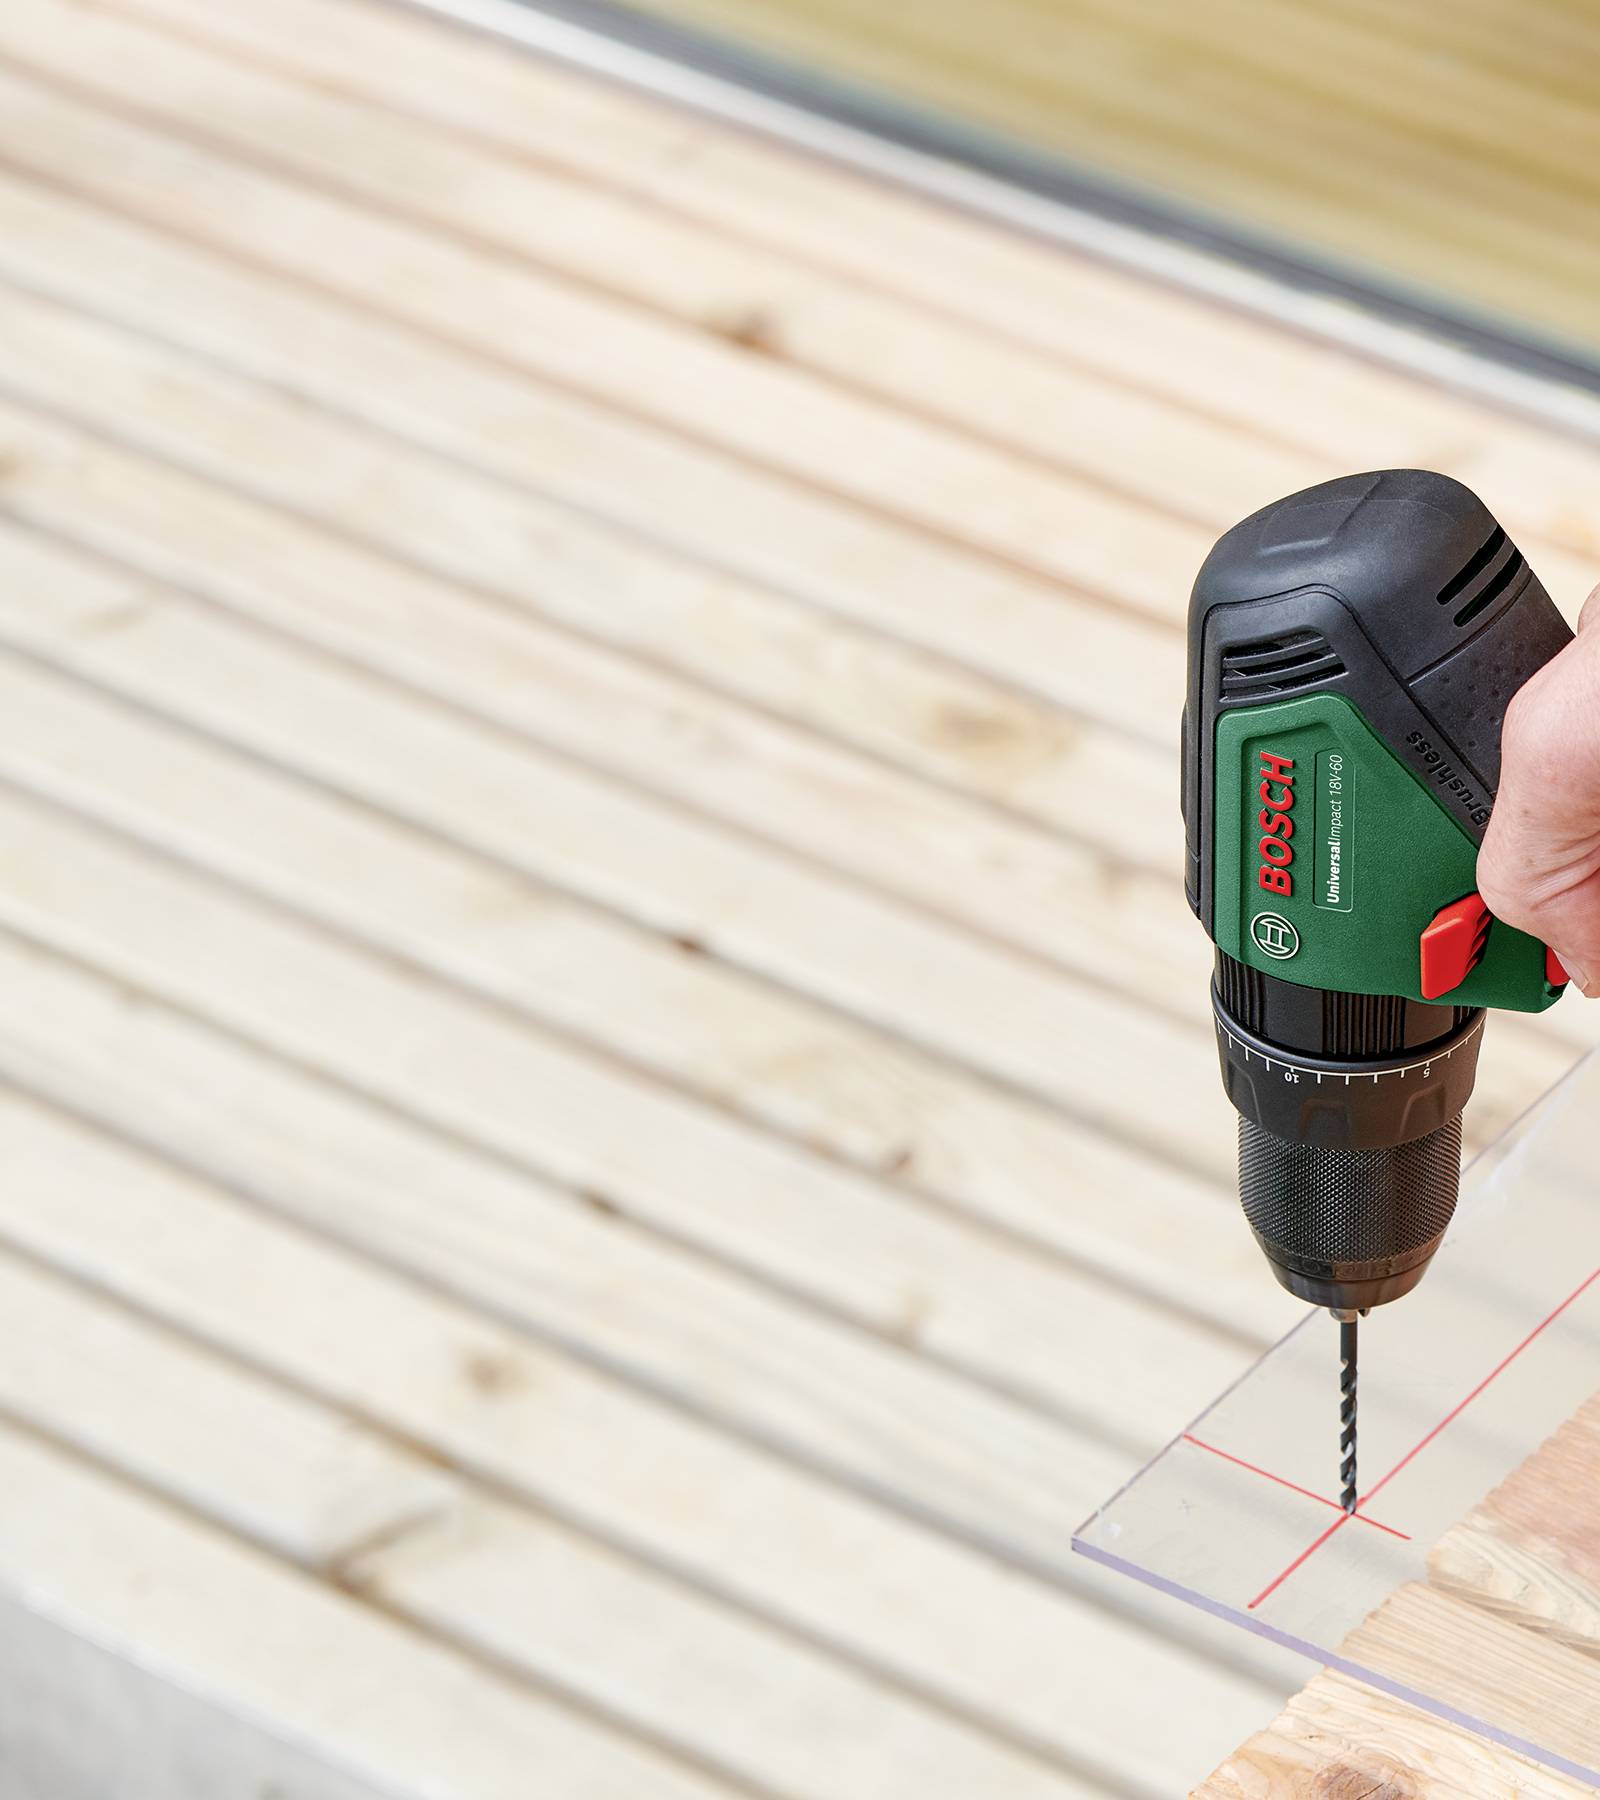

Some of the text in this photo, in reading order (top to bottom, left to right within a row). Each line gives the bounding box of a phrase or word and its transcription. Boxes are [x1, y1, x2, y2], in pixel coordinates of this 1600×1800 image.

[1259, 750, 1294, 897] BOSCH
[1406, 731, 1489, 827] Brushless
[1326, 754, 1343, 904] UniversalImpact 18V-60
[1284, 1071, 1300, 1084] 10
[1422, 1068, 1431, 1078] 5
